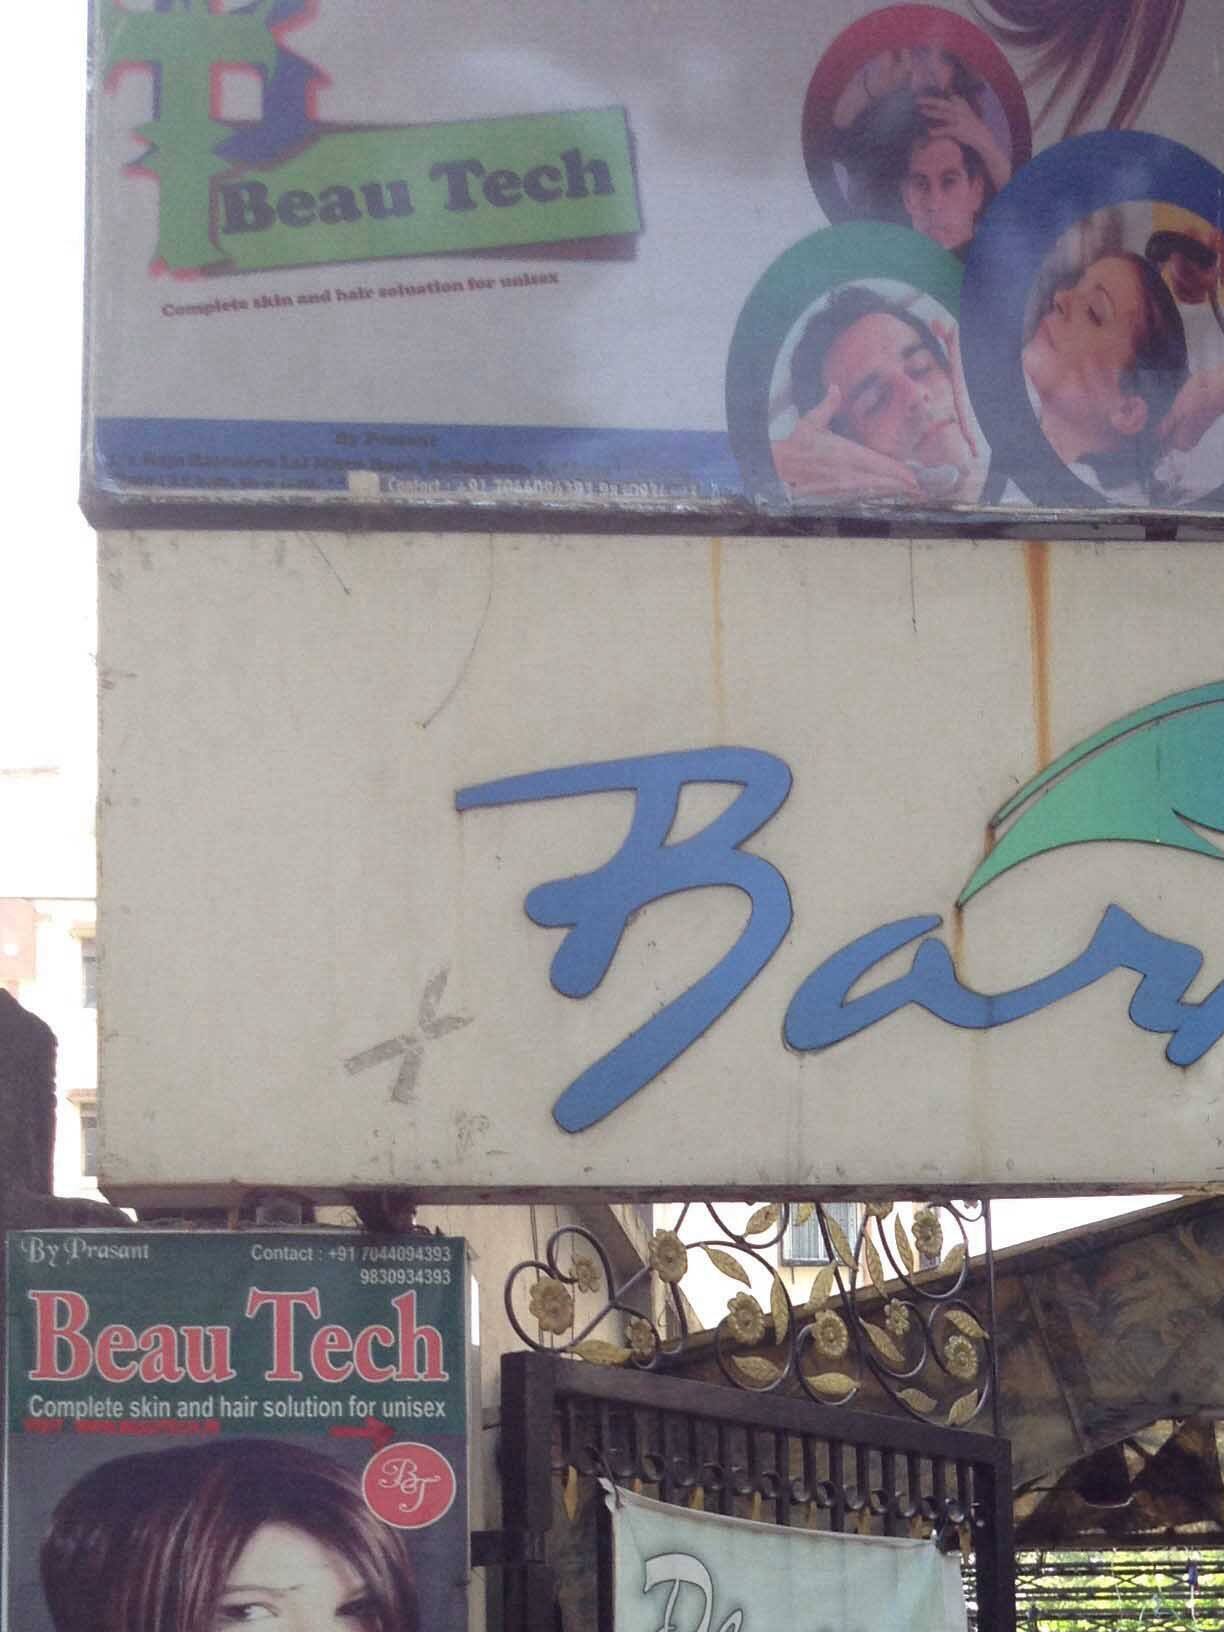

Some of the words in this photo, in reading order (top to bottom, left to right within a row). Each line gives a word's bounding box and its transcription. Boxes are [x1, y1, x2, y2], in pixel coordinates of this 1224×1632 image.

[219, 174, 414, 234] Beau
[429, 148, 616, 212] Tech
[161, 298, 249, 318] Complete
[297, 288, 331, 305] and
[335, 284, 375, 302] hair
[467, 275, 496, 291] for
[21, 1236, 59, 1268] By
[63, 1237, 149, 1266] Prasant
[251, 1244, 314, 1261] Contact
[328, 1246, 355, 1262] +91
[360, 1268, 451, 1285] 9830934393
[28, 1289, 236, 1383] Beau
[245, 1286, 449, 1384] Tech
[29, 1395, 125, 1422] Complete
[129, 1395, 171, 1418] skin
[177, 1395, 214, 1418] and
[220, 1395, 258, 1418] hair
[263, 1395, 343, 1418] solution
[349, 1395, 374, 1418] for
[382, 1396, 446, 1418] unisex
